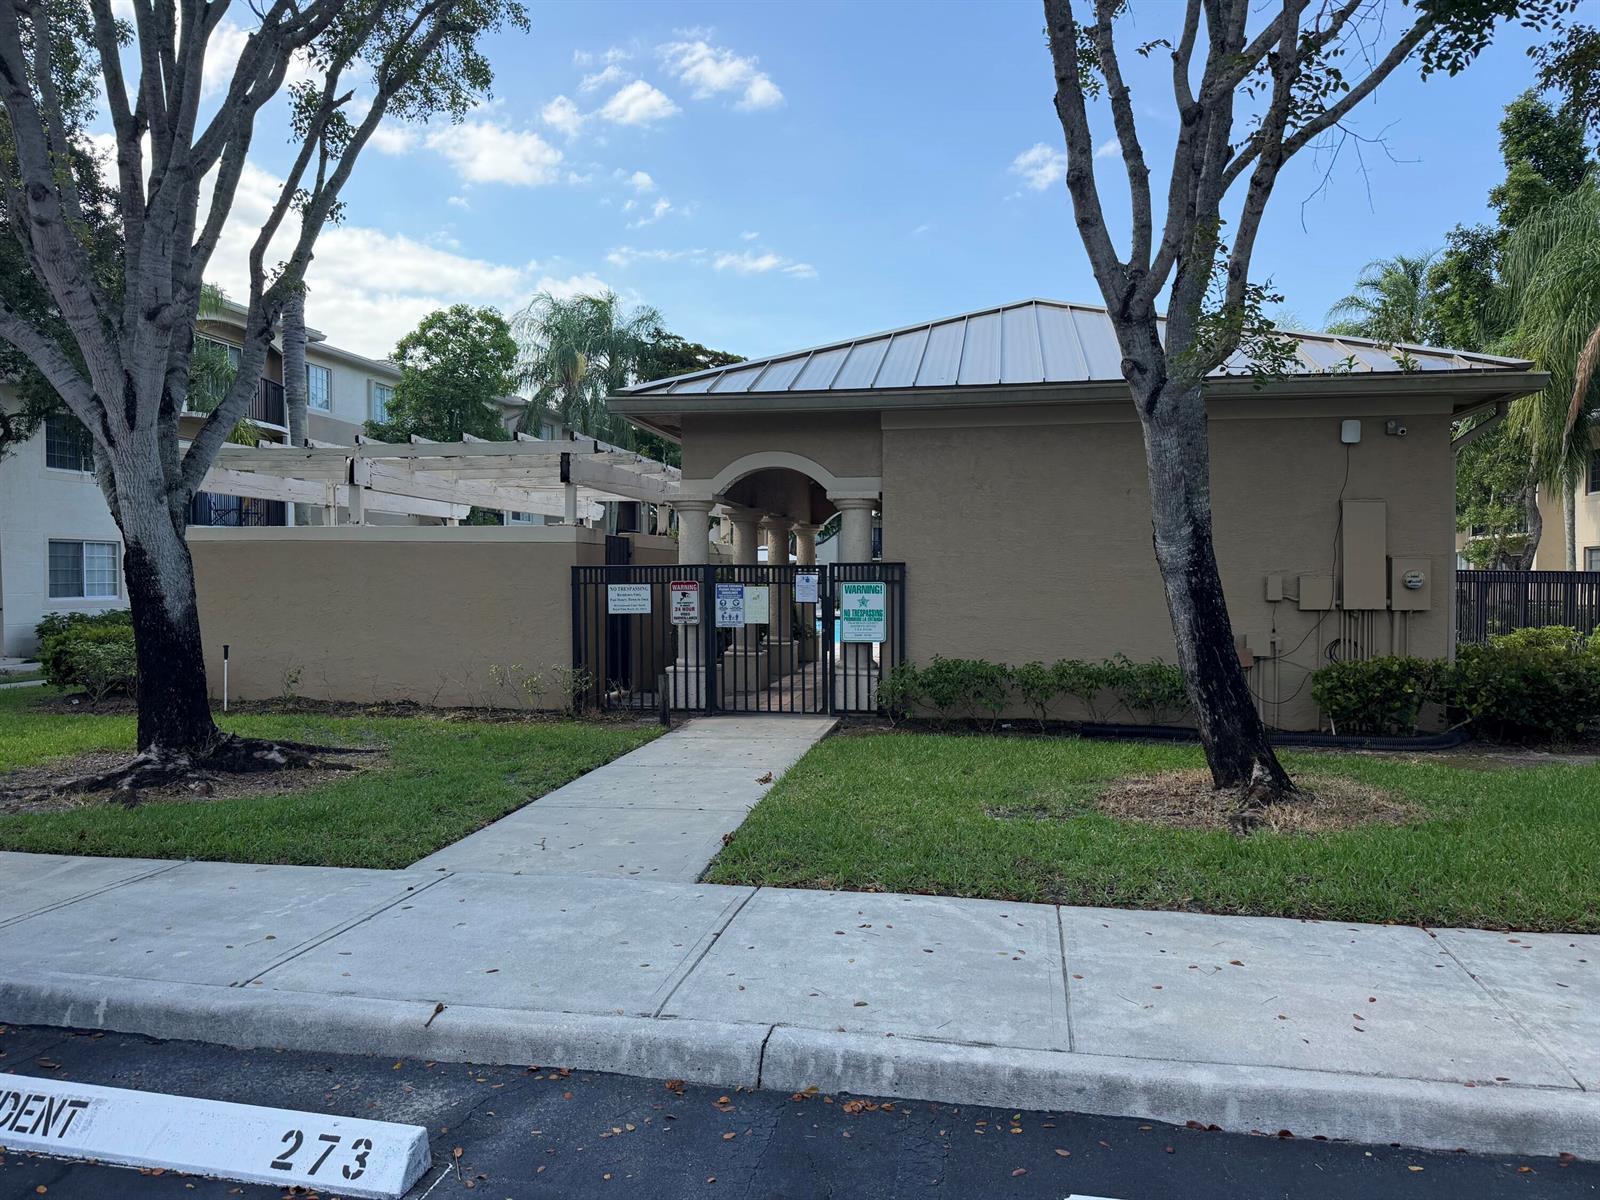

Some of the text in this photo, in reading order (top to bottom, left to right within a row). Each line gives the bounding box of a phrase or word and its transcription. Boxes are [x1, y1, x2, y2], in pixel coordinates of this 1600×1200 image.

[844, 585, 883, 594] WARNING!
[844, 609, 883, 617] NO TRESPASSING
[0, 1090, 89, 1138] DENT
[270, 1130, 373, 1180] 273
